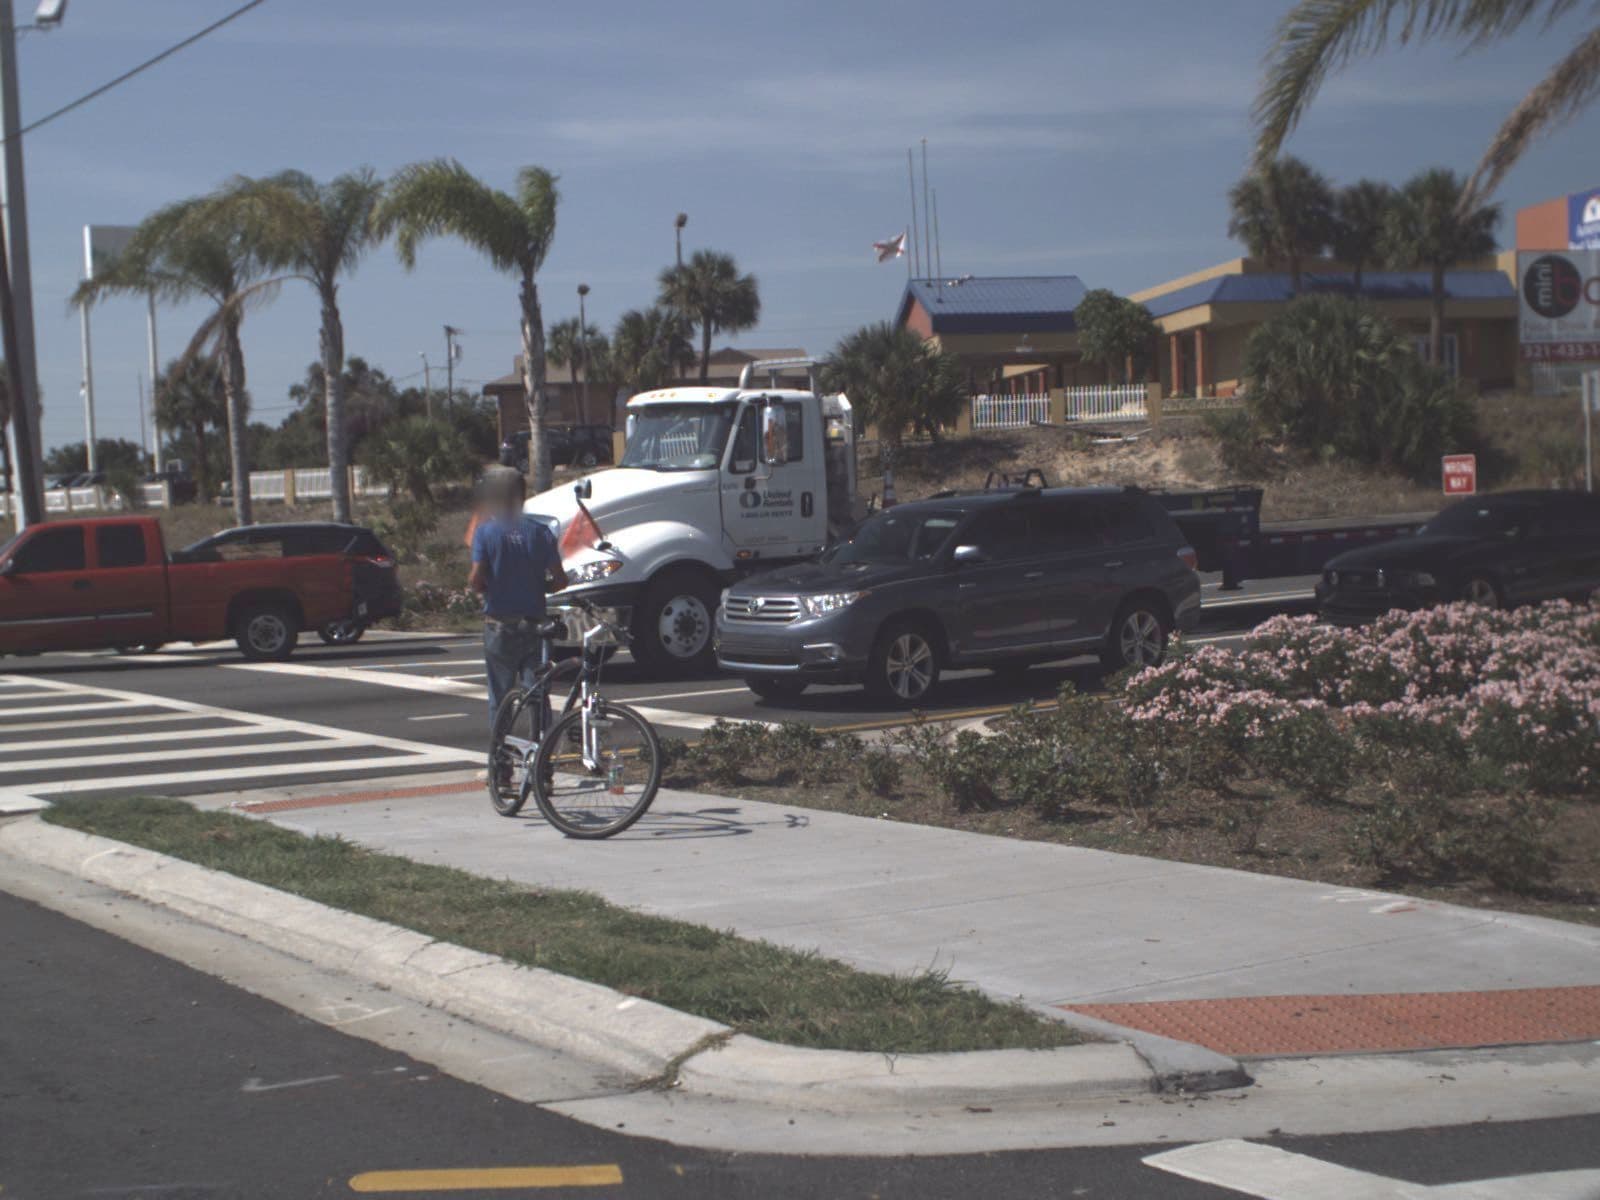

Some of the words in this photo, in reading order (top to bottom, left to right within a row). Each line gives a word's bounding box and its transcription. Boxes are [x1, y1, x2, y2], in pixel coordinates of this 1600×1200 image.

[1536, 264, 1553, 307] mini
[1444, 461, 1473, 473] WRONG
[1450, 477, 1467, 488] WAY
[763, 489, 792, 498] United
[763, 499, 793, 507] Rentals
